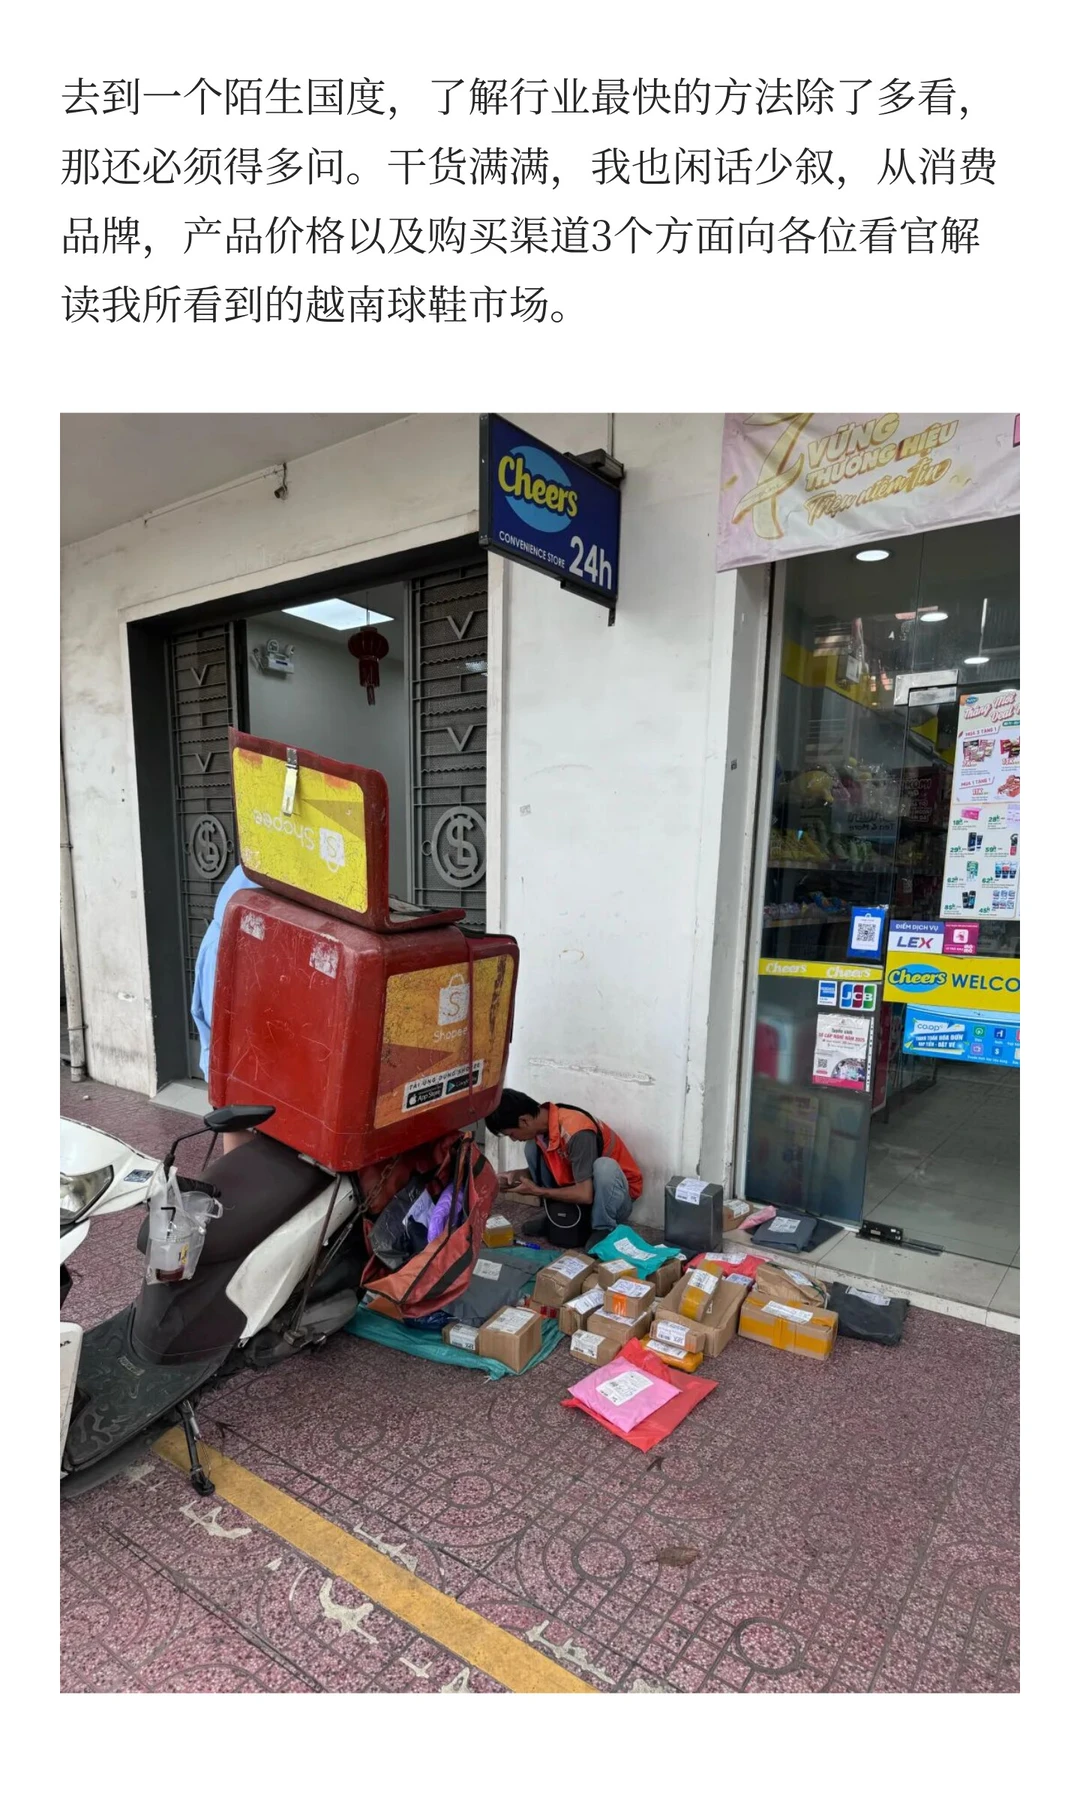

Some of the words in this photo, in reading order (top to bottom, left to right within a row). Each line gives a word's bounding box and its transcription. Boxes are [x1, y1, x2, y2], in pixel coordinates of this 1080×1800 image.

[498, 455, 578, 517] Cheers
[499, 530, 546, 560] CONVENIENCE
[547, 552, 565, 568] STORE
[569, 535, 612, 590] 24h
[253, 809, 315, 851] Shopee
[896, 936, 934, 948] LEX
[765, 962, 807, 973] Cheers
[826, 966, 871, 978] Cheers
[888, 968, 947, 985] Cheers
[951, 973, 1020, 992] WELCO
[433, 1026, 468, 1043] Shopee
